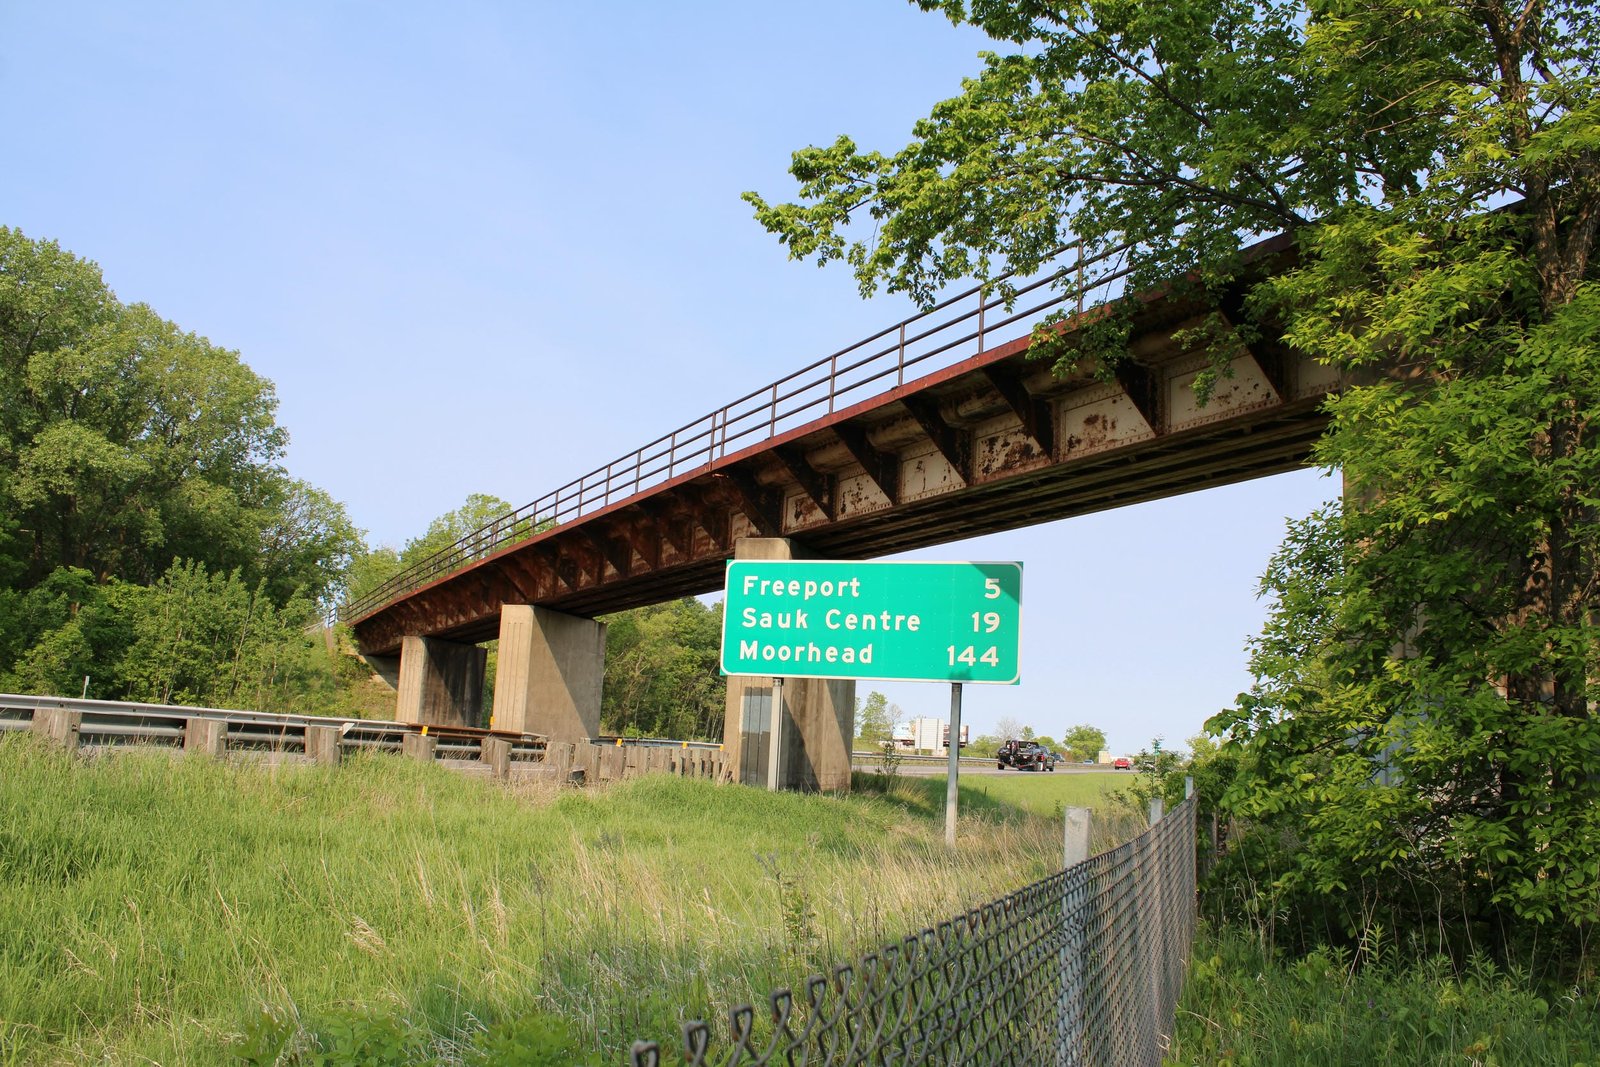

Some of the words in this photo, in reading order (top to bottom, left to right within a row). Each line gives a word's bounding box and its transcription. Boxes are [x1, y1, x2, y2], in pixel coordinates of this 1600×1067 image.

[743, 575, 861, 600] Freeport
[984, 578, 1001, 599] 5
[741, 607, 809, 629] Sauk
[825, 609, 921, 631] Centre
[971, 611, 1001, 633] 19
[739, 639, 873, 664] Moorhead
[947, 645, 1000, 667] 144
